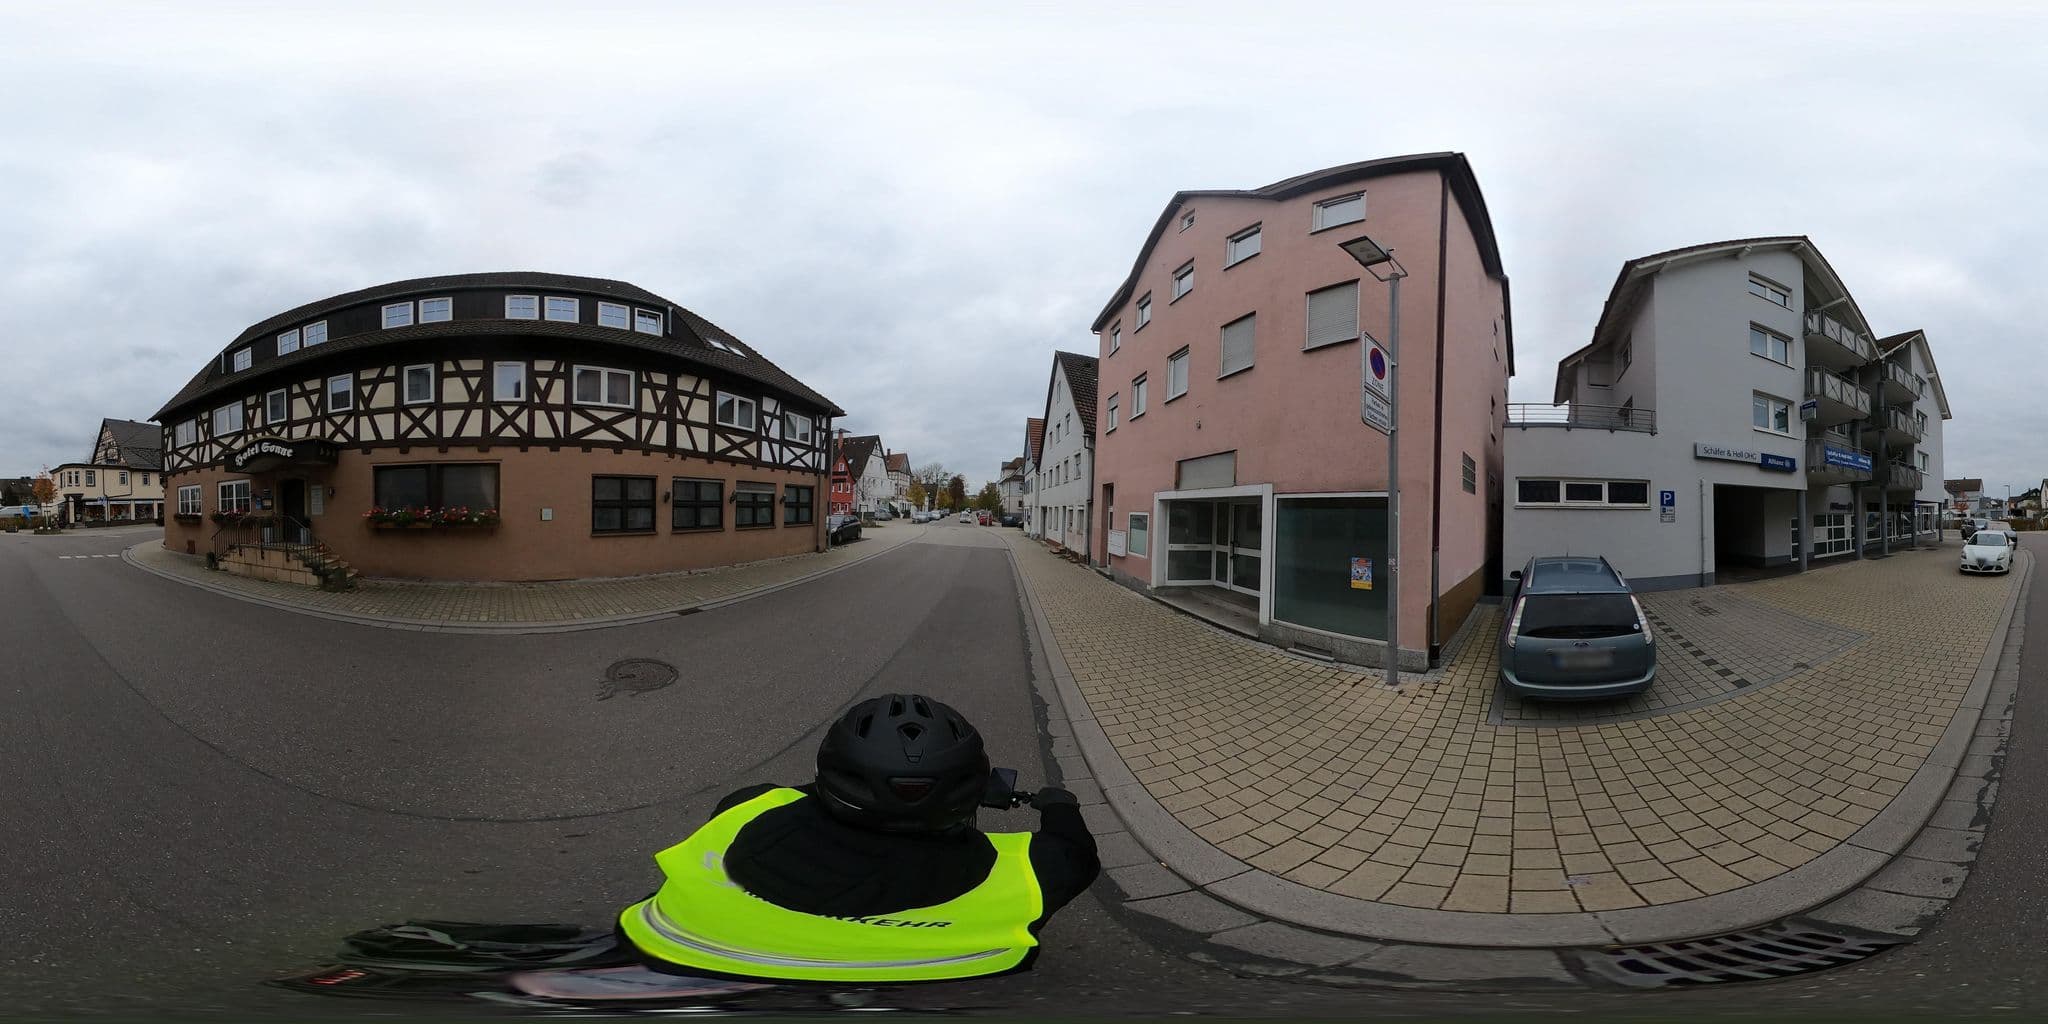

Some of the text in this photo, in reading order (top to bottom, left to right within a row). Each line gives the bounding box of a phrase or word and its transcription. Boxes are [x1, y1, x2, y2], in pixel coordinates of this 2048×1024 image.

[235, 442, 294, 466] Hotel Sonne
[1704, 447, 1725, 456] Schäfer
[1744, 452, 1757, 460] OHG
[1767, 458, 1784, 466] Allianz
[1663, 492, 1672, 505] P
